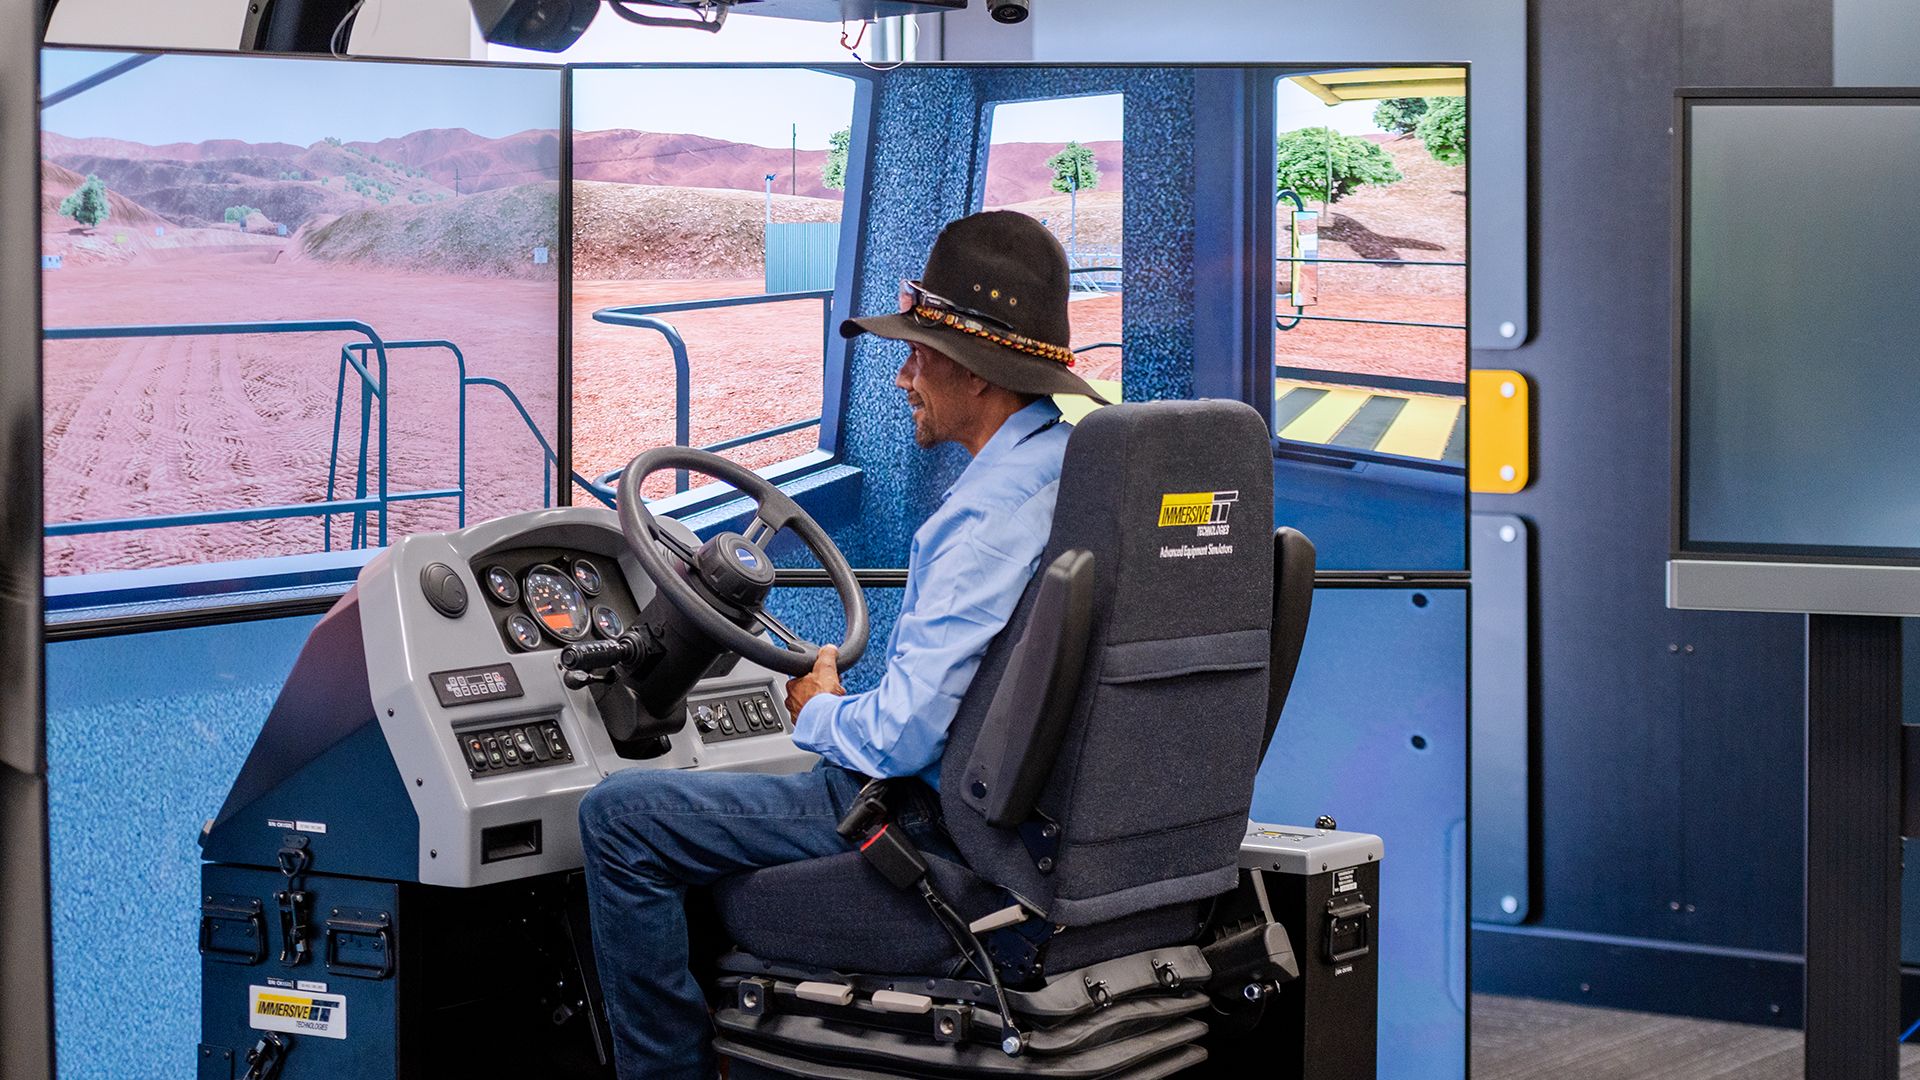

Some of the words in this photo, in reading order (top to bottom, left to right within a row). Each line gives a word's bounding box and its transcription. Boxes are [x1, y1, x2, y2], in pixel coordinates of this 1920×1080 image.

[1161, 505, 1211, 525] IMMERSIVE
[1160, 545, 1183, 558] Advanced
[1183, 544, 1208, 559] Equipment
[1208, 543, 1233, 555] Simulators
[257, 1000, 309, 1020] IMMERSIVE
[296, 1020, 329, 1031] TECHNOLOGIES
